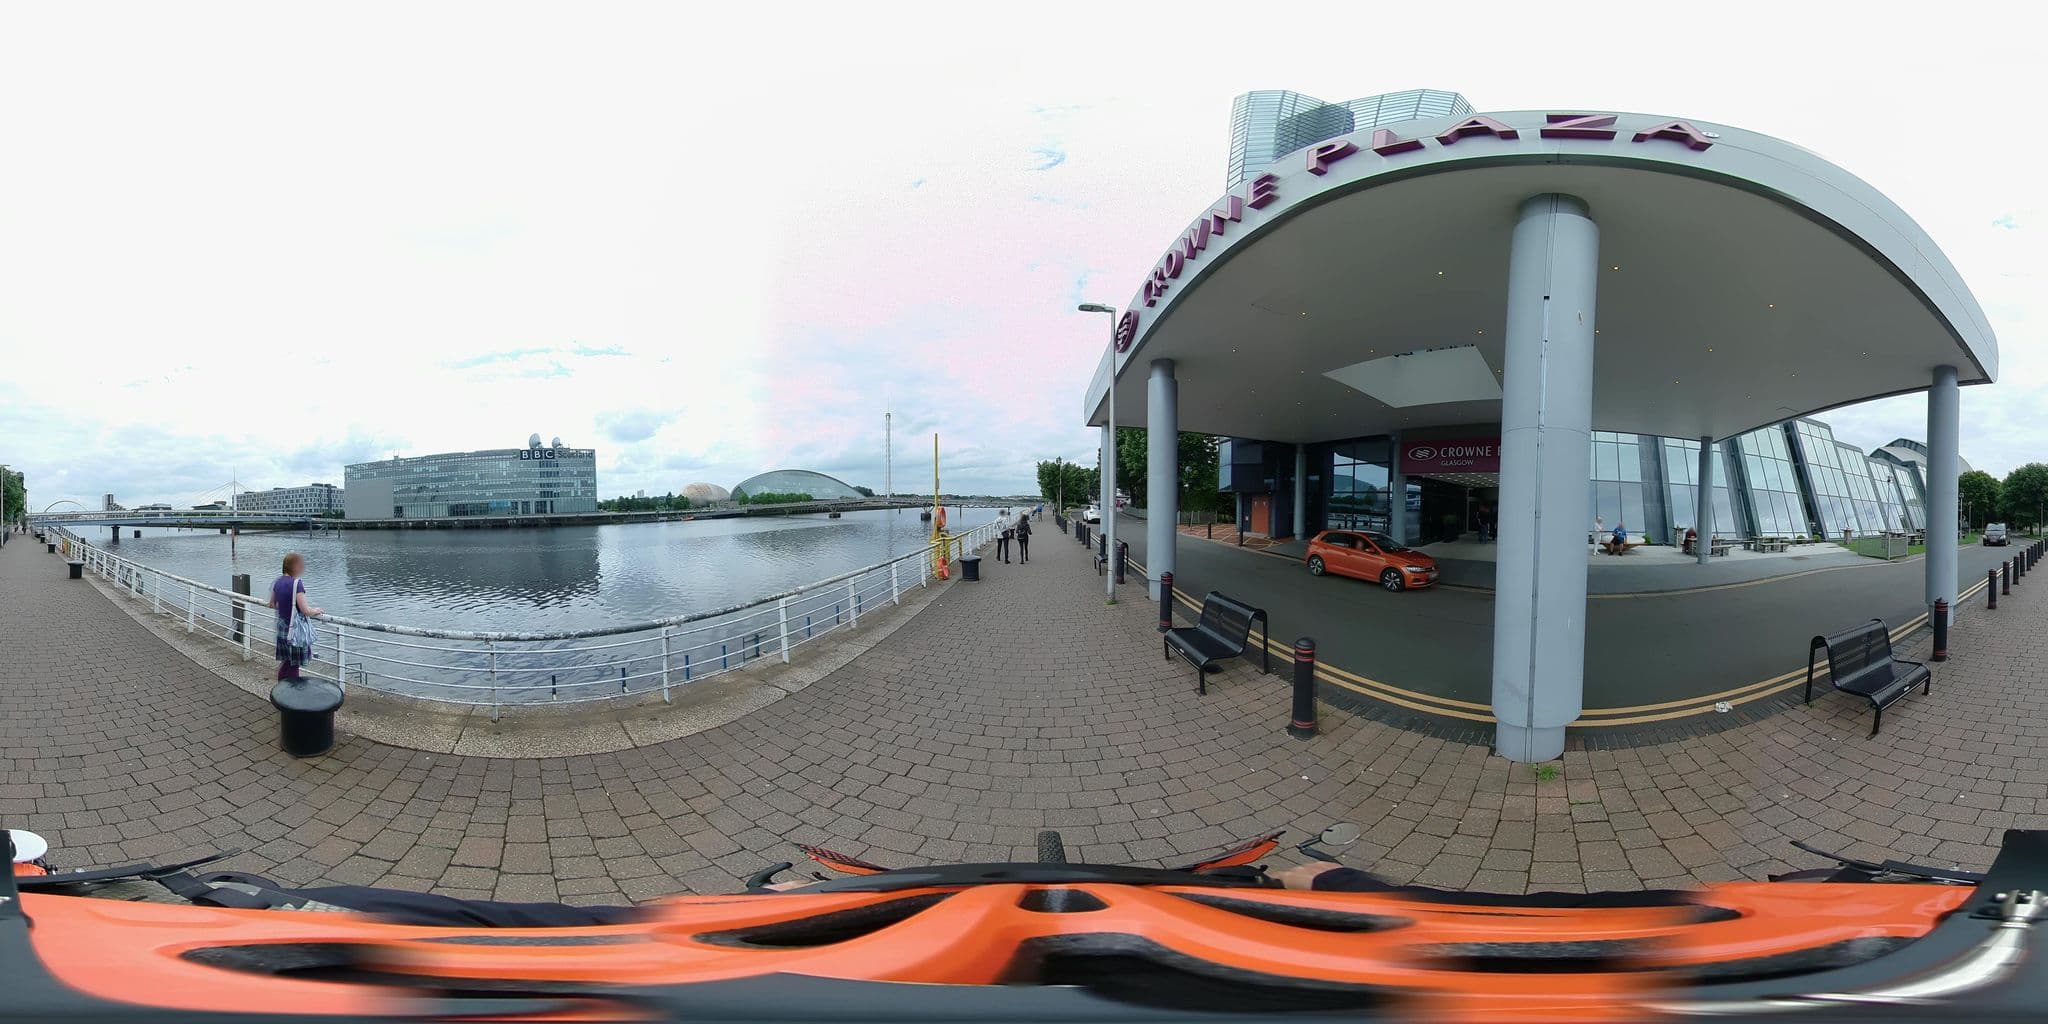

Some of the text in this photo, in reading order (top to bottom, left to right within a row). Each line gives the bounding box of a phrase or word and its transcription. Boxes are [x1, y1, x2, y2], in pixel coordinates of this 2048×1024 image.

[1142, 113, 1714, 307] CROWNE PLAZA
[521, 449, 555, 460] BBC
[1441, 446, 1492, 458] CROWNE
